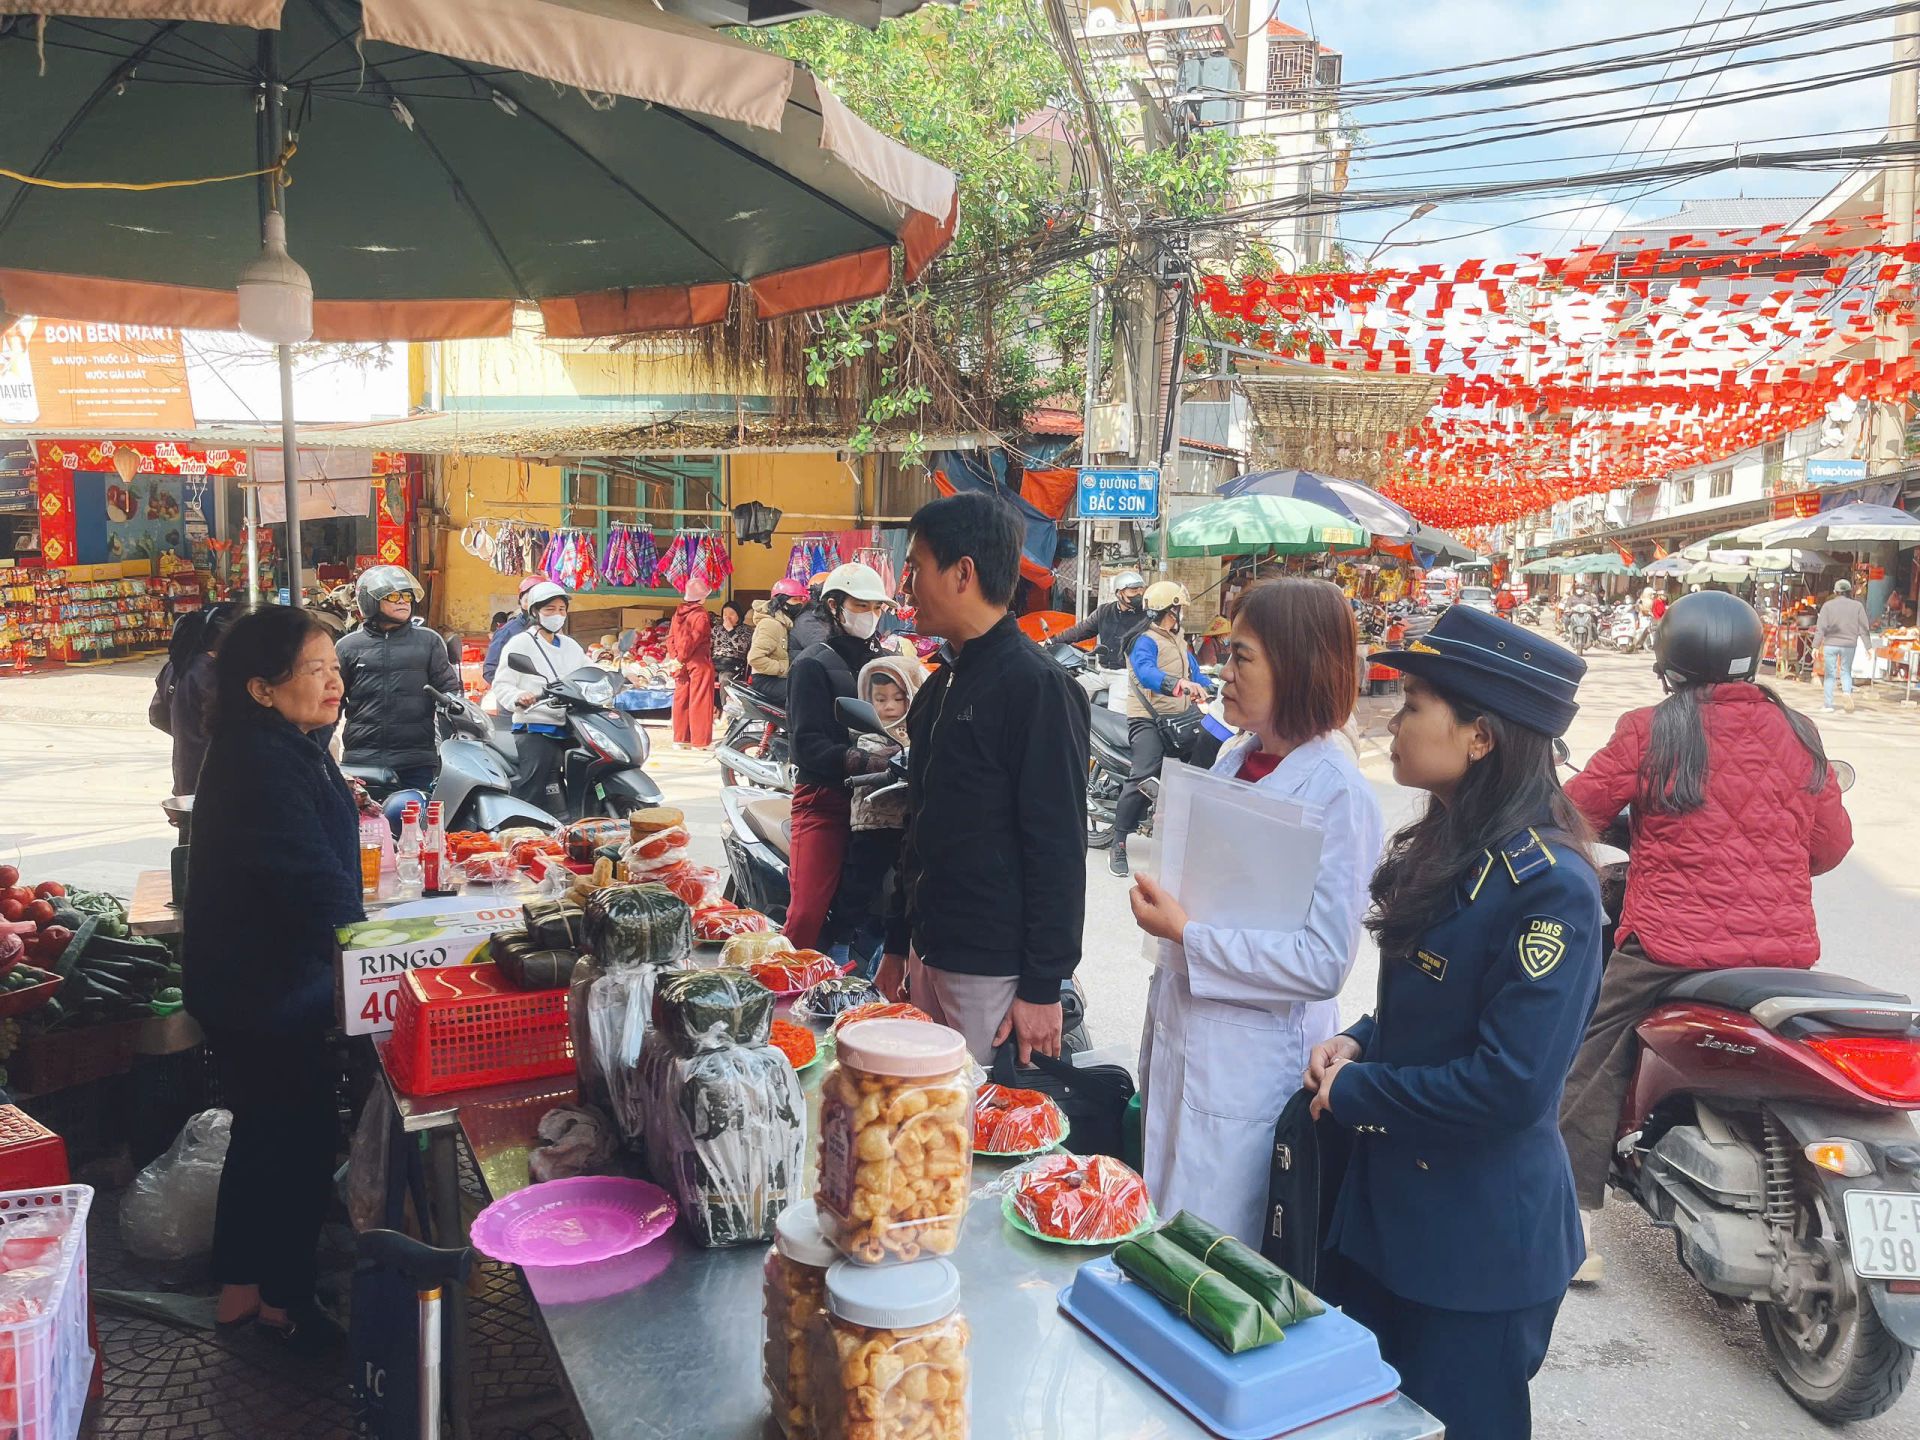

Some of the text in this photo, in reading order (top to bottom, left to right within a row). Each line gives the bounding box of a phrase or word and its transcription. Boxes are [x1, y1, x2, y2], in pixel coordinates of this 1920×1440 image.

[1811, 465, 1863, 477] vinaphone
[1099, 476, 1137, 489] ĐƯỜNG
[1089, 491, 1145, 511] BẮC SƠN
[1530, 920, 1562, 937] DMS
[360, 946, 448, 977] RINGO
[1860, 1236, 1917, 1273] 298
